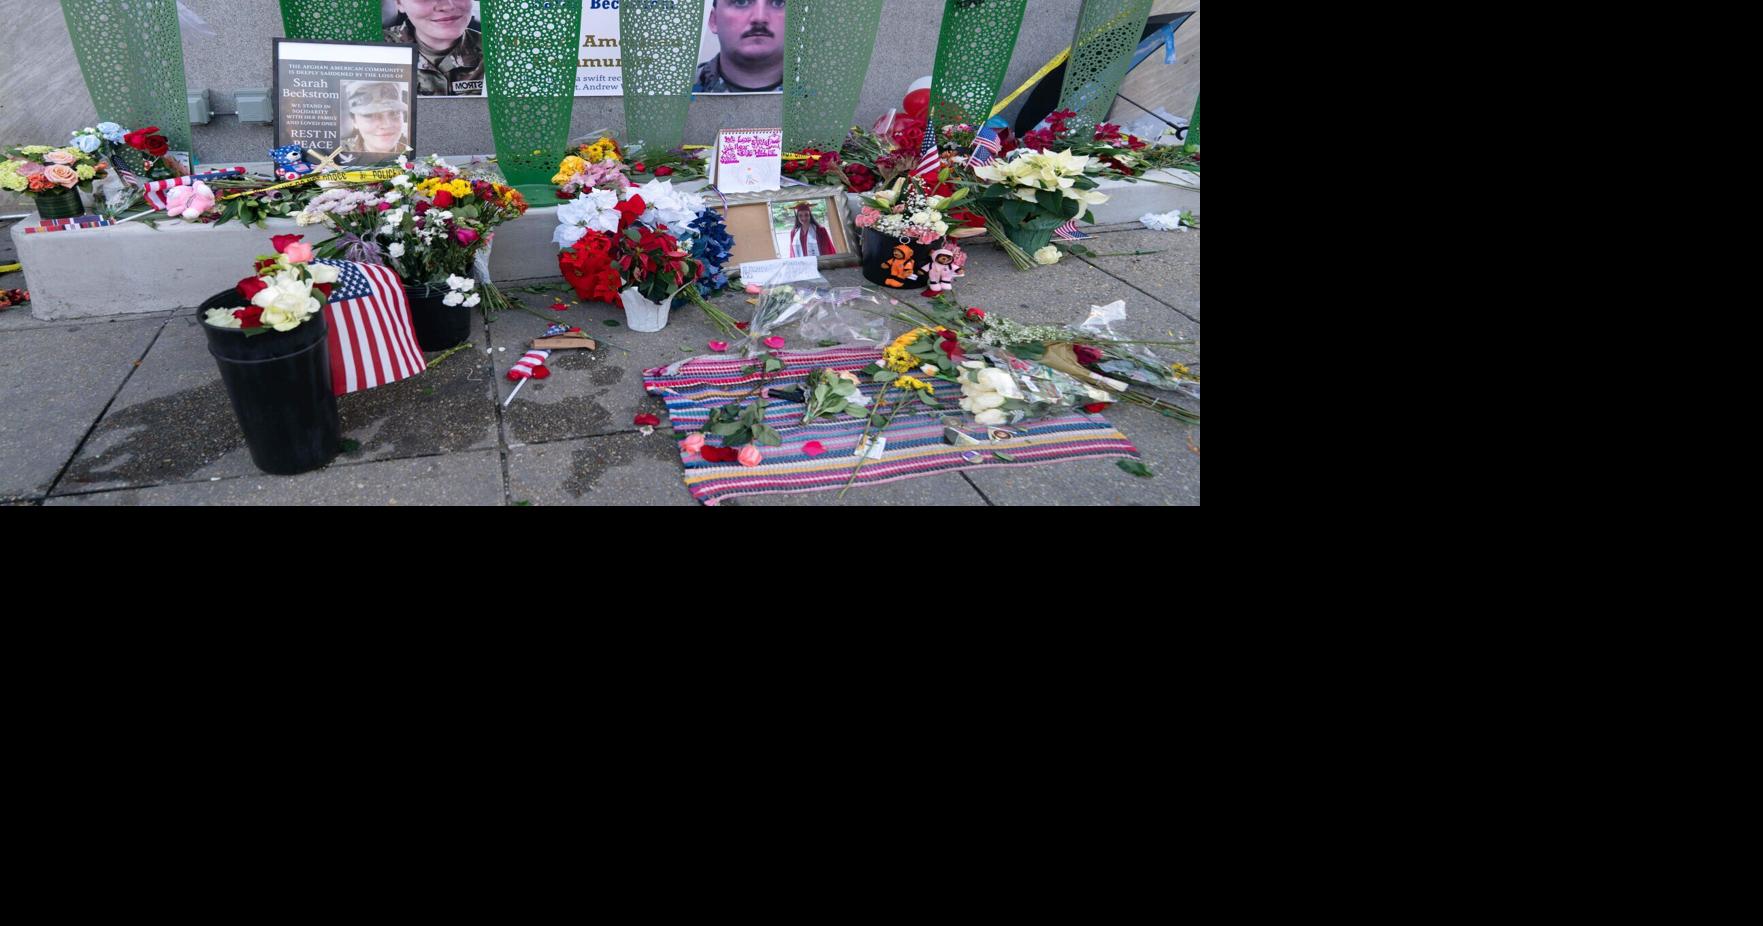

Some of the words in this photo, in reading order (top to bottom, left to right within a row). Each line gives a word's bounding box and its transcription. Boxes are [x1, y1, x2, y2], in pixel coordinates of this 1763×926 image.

[293, 78, 328, 88] Sarah
[582, 83, 618, 91] Andrew
[283, 89, 339, 99] Beckstrom
[291, 129, 321, 138] REST
[323, 130, 337, 139] IN
[293, 140, 333, 149] PEACE
